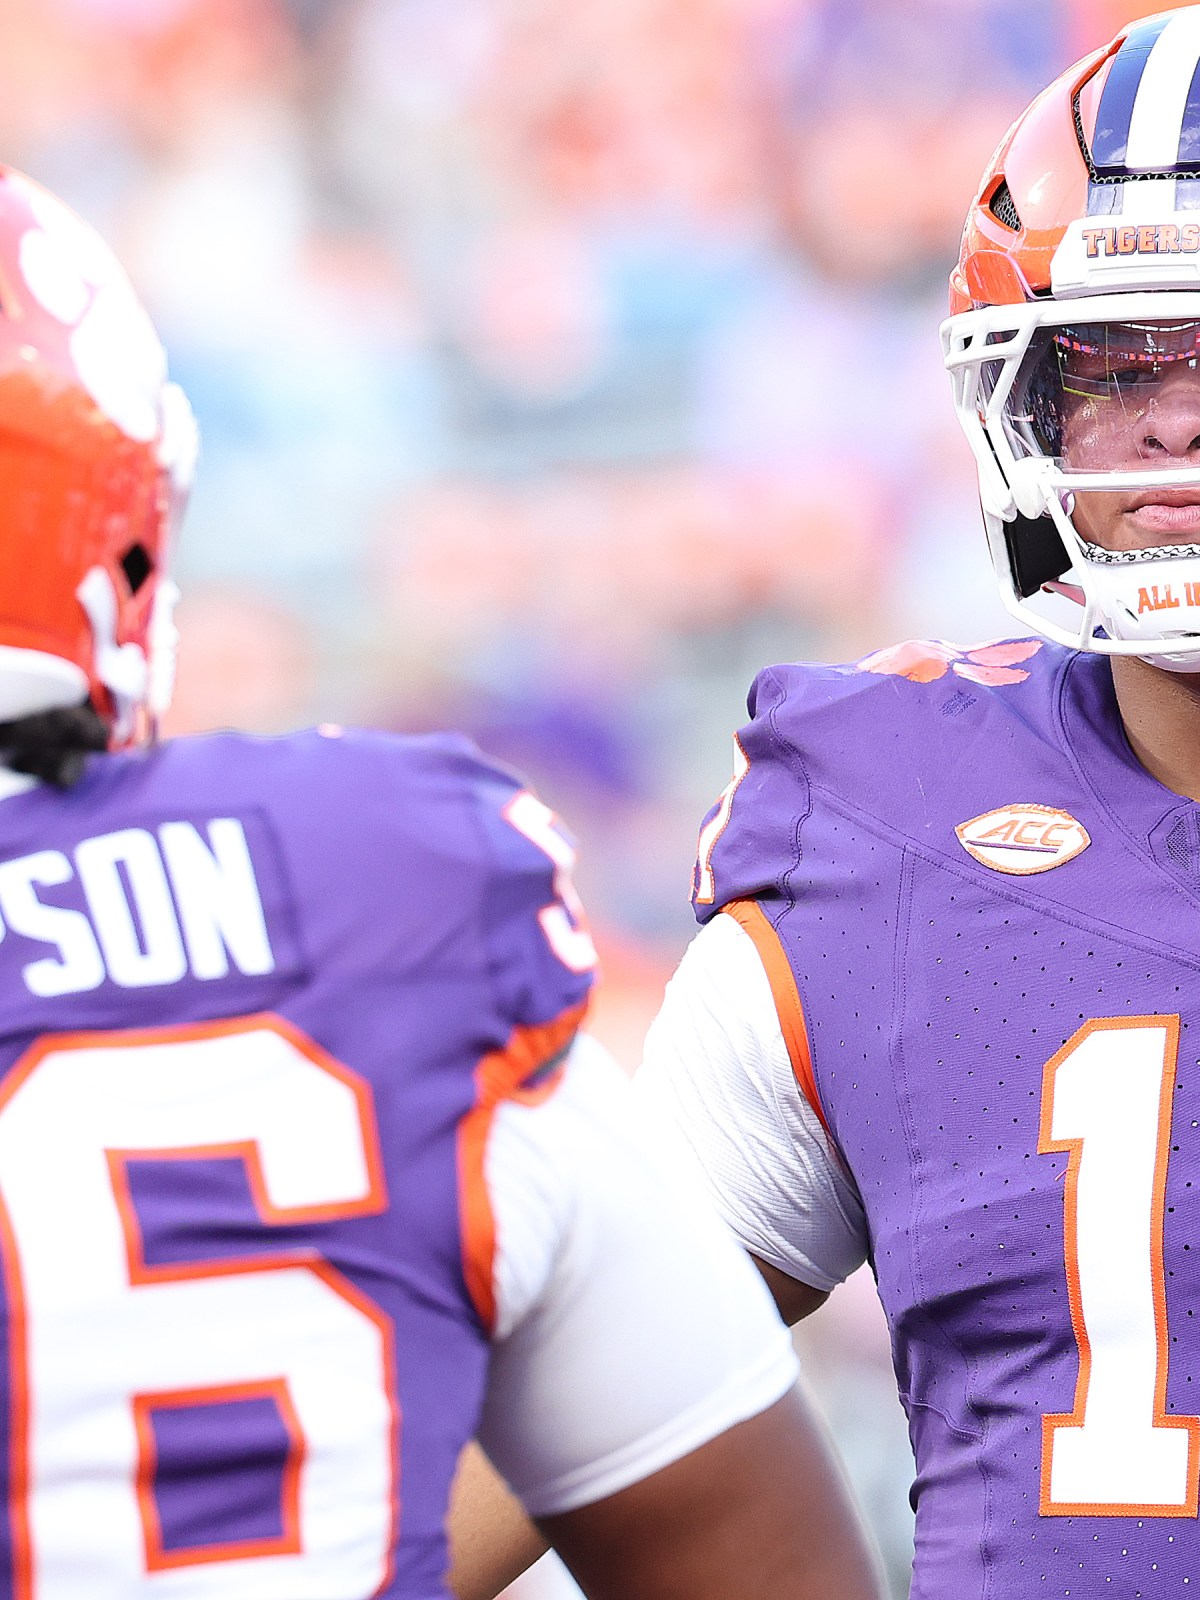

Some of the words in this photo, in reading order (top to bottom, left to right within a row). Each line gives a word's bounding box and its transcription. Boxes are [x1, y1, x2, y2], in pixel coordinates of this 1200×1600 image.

[1137, 584, 1180, 615] ALL
[976, 819, 1075, 847] ACC
[0, 817, 275, 997] SON
[0, 1011, 397, 1600] 6
